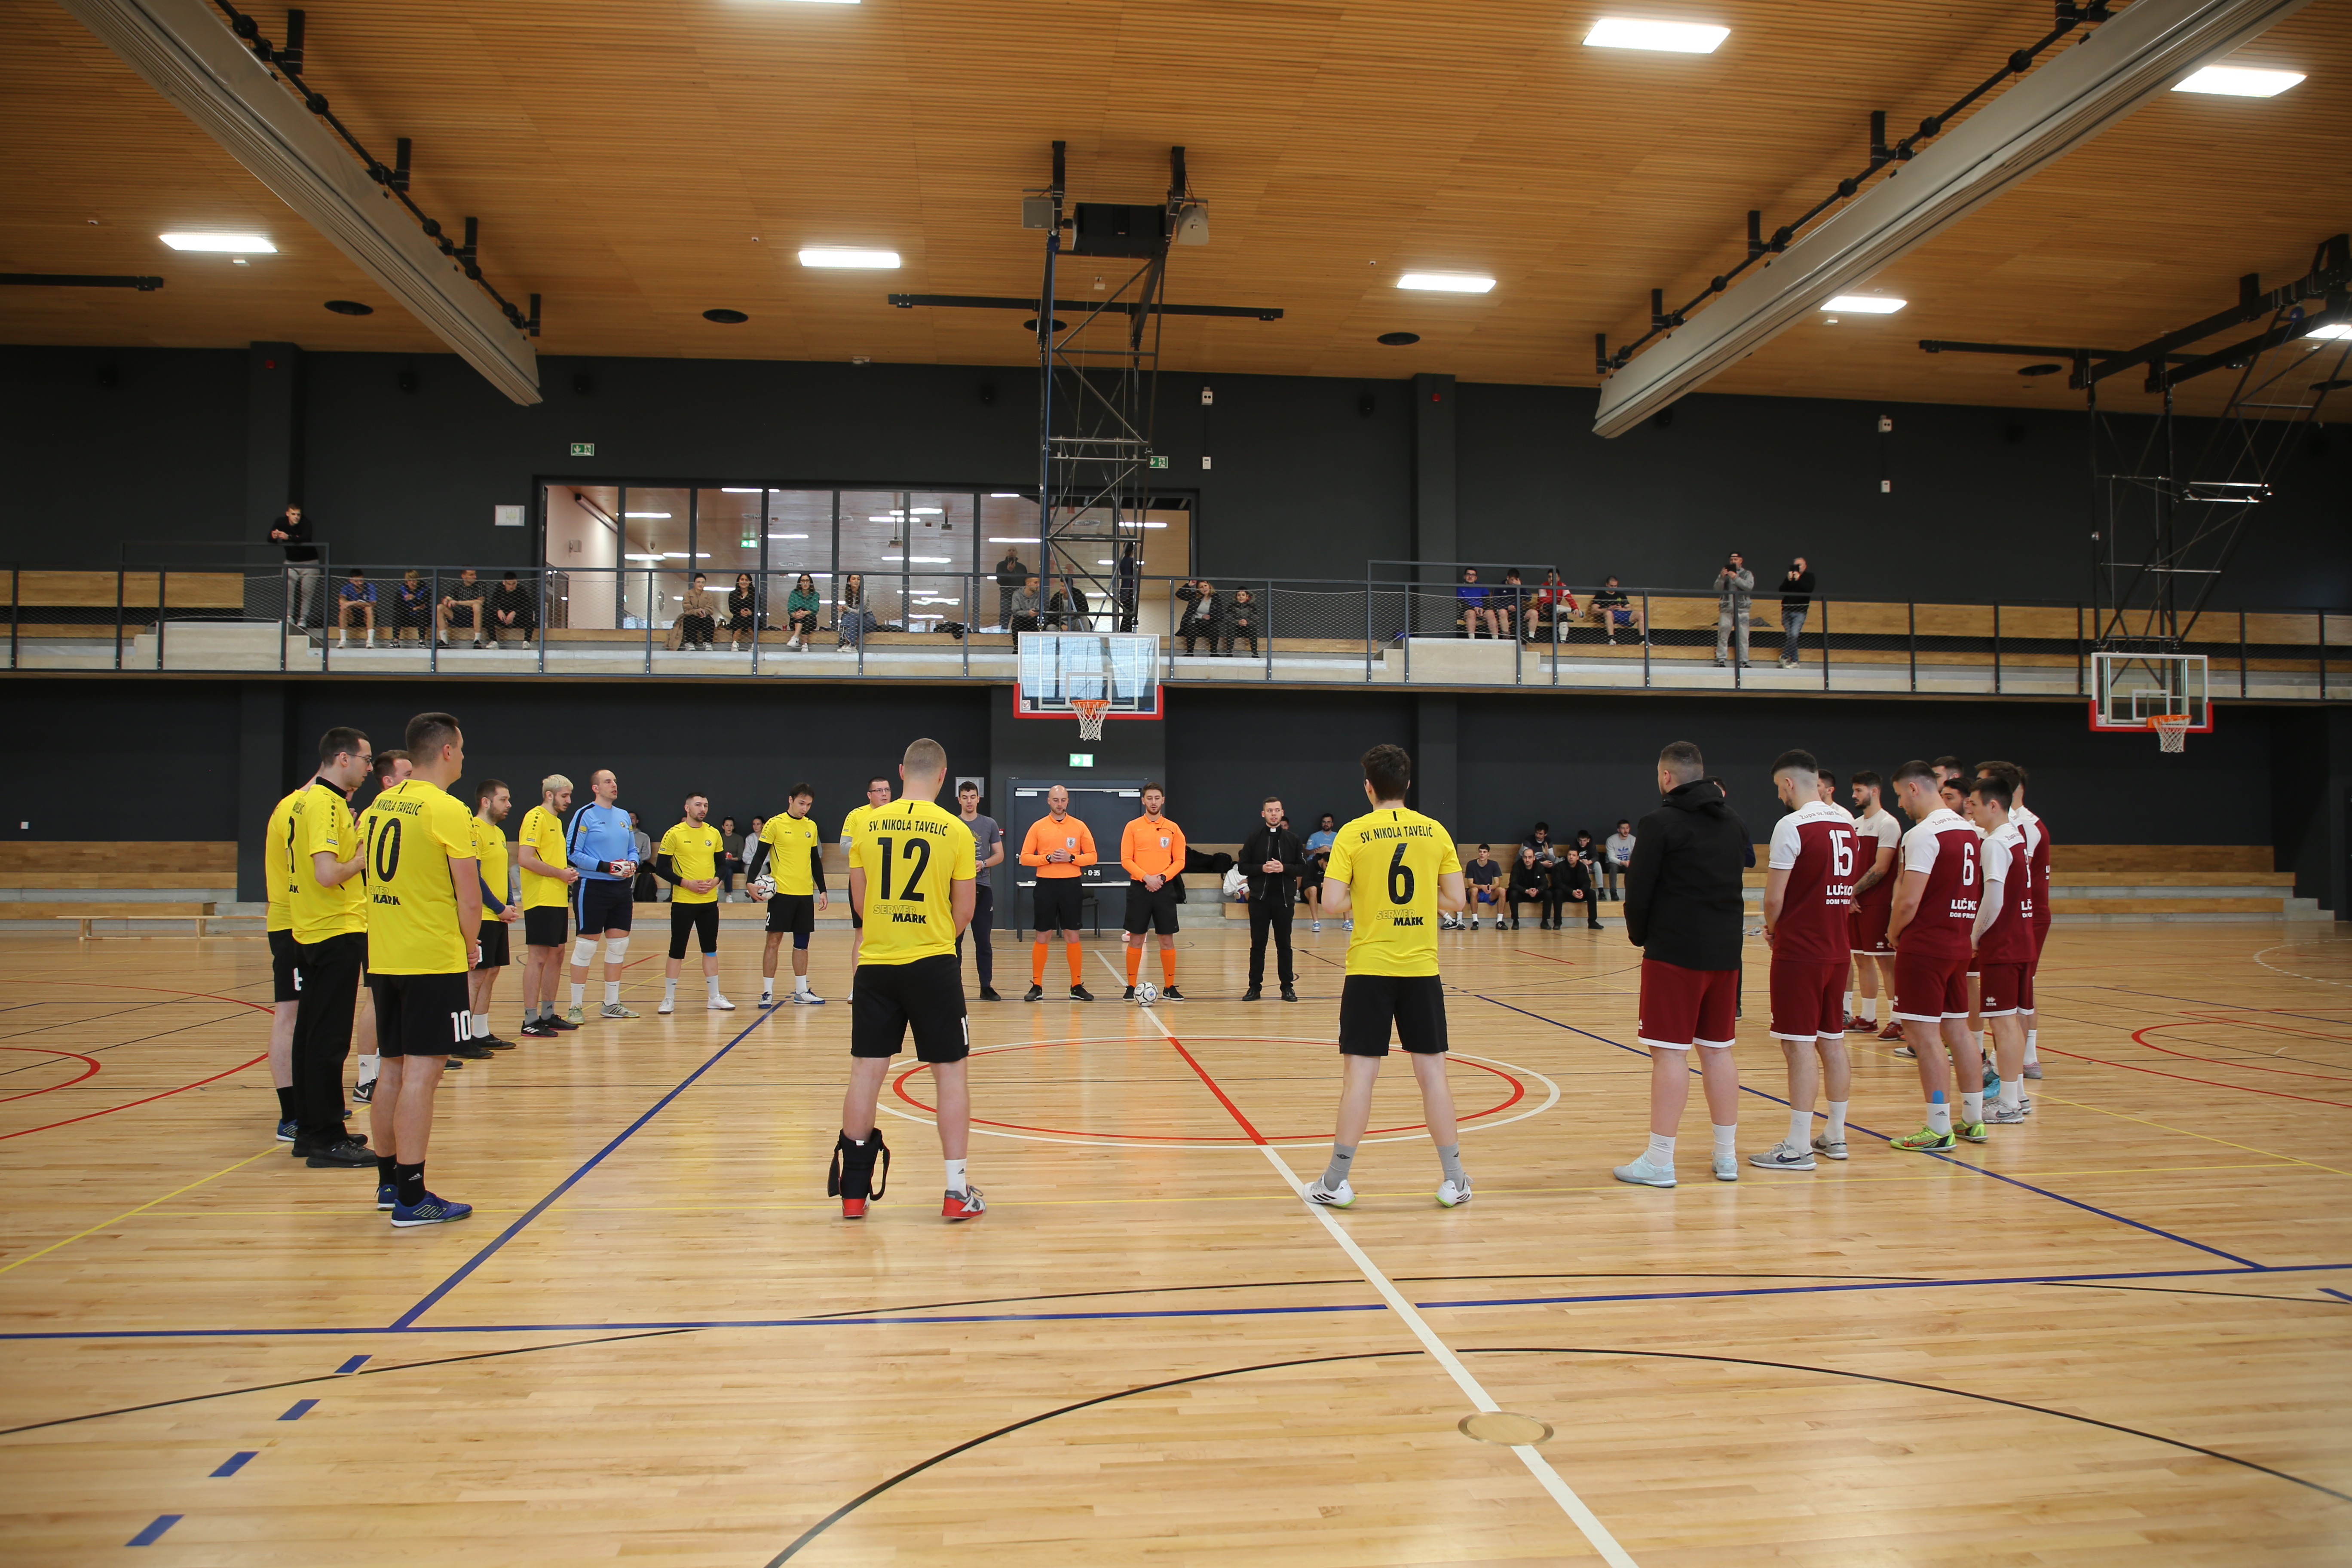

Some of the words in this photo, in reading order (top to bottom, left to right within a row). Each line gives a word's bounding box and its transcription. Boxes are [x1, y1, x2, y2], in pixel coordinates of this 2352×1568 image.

[375, 799, 397, 812] NIKOLA
[395, 801, 424, 816] TAVELIĆ
[869, 820, 879, 832] SV.
[882, 819, 912, 831] NIKOLA
[915, 820, 949, 836] TAVELIĆ
[1360, 830, 1372, 843] SV.
[1373, 827, 1403, 839] NIKOLA
[1403, 824, 1433, 837] TAVELIĆ
[366, 816, 401, 882] 10
[1829, 830, 1853, 876] 15
[878, 837, 931, 902] 12
[1963, 842, 1975, 886] 6
[1388, 843, 1414, 905] 6
[373, 894, 401, 905] MARK
[873, 904, 916, 915] SERVER
[892, 913, 927, 924] MARK
[1376, 909, 1415, 920] SERVER
[1393, 916, 1424, 926] MARK
[451, 1010, 472, 1042] 10
